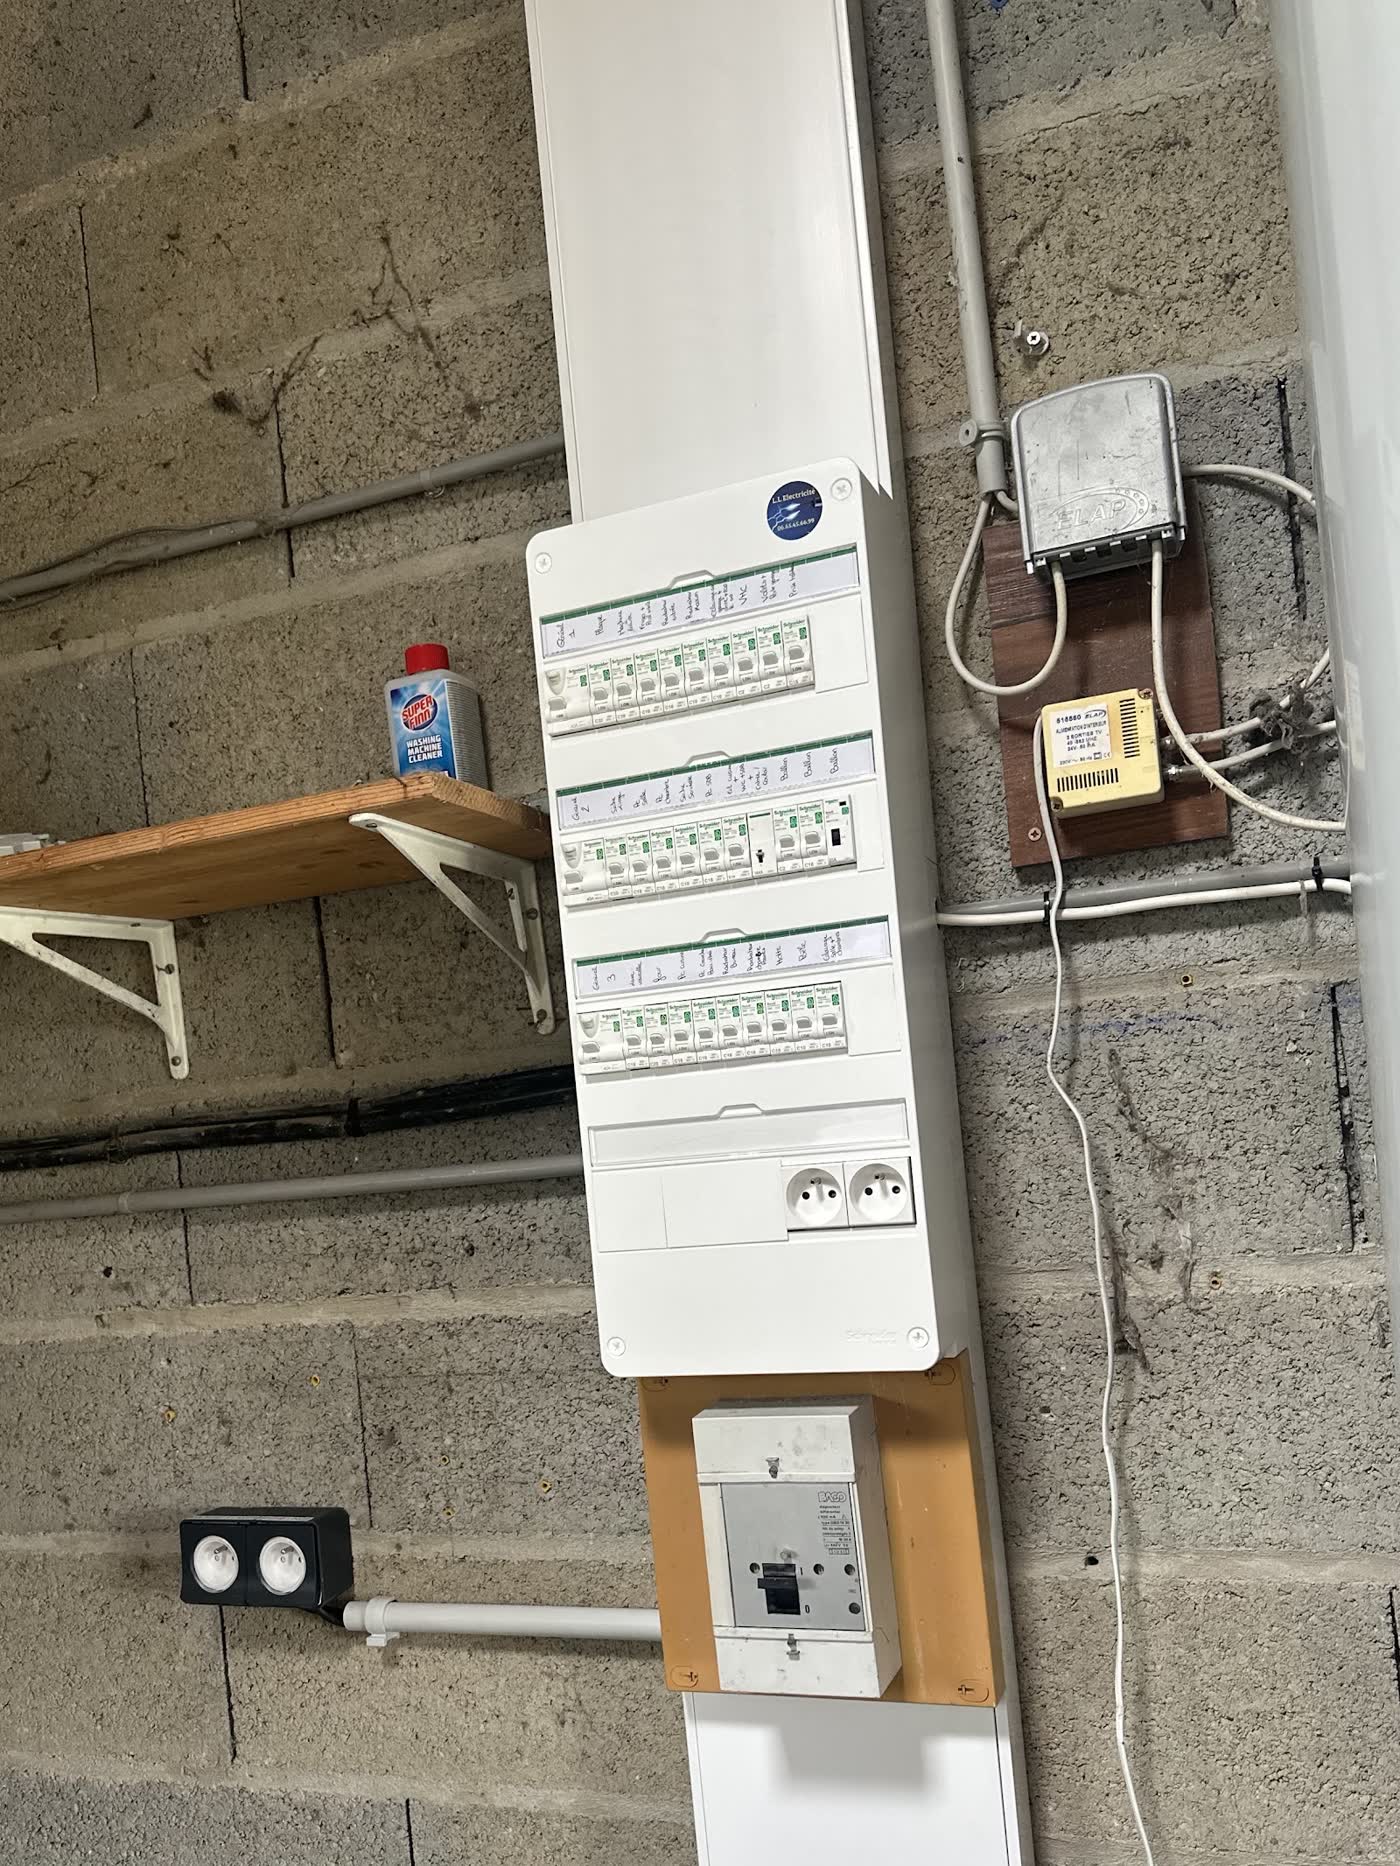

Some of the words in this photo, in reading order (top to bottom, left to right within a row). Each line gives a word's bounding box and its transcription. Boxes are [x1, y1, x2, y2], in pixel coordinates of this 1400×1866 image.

[1057, 500, 1126, 531] ELAP
[738, 584, 748, 606] VMC
[402, 694, 433, 721] SUPER
[406, 734, 442, 748] WASHING
[407, 742, 442, 756] MACHINE
[408, 750, 443, 764] CLEANER
[606, 974, 616, 982] 3
